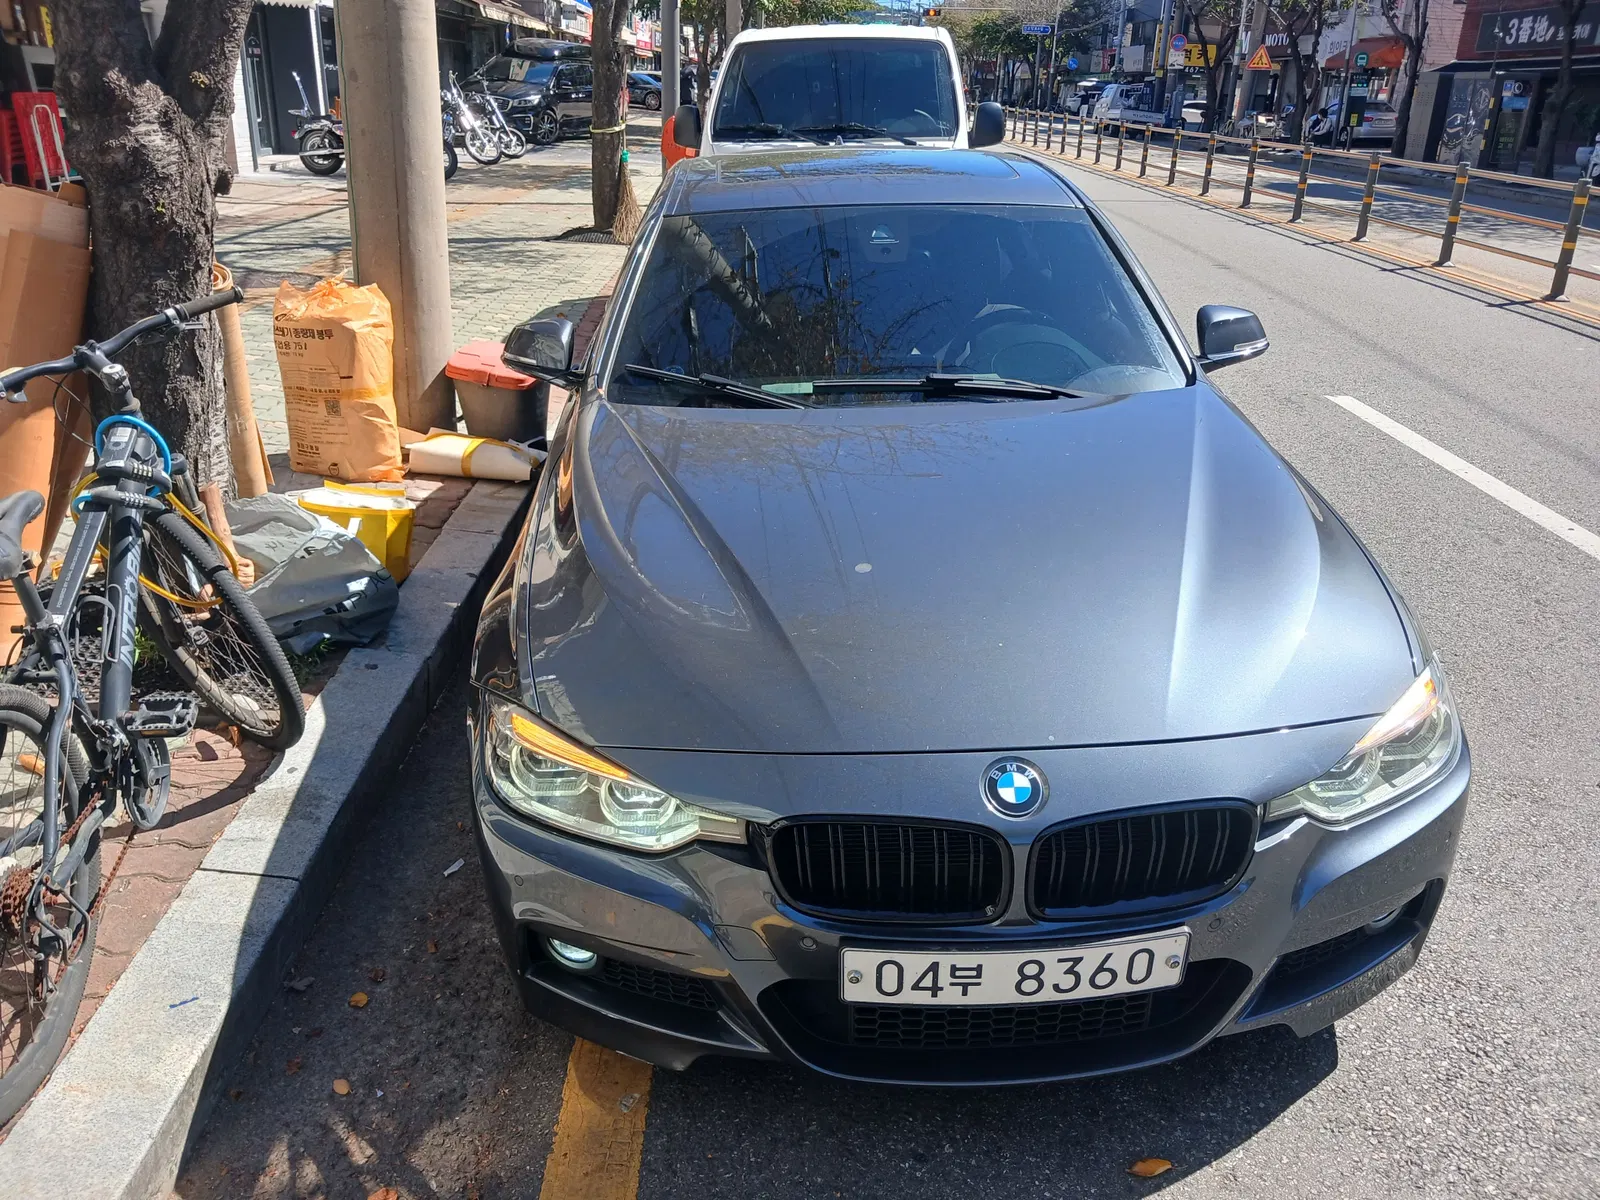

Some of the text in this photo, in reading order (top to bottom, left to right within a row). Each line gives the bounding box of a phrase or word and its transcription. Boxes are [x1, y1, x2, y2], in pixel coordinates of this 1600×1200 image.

[1505, 15, 1549, 45] 3番地
[316, 329, 335, 341] 봉투
[990, 764, 1035, 780] BMW
[875, 948, 1156, 998] 04부 8360
